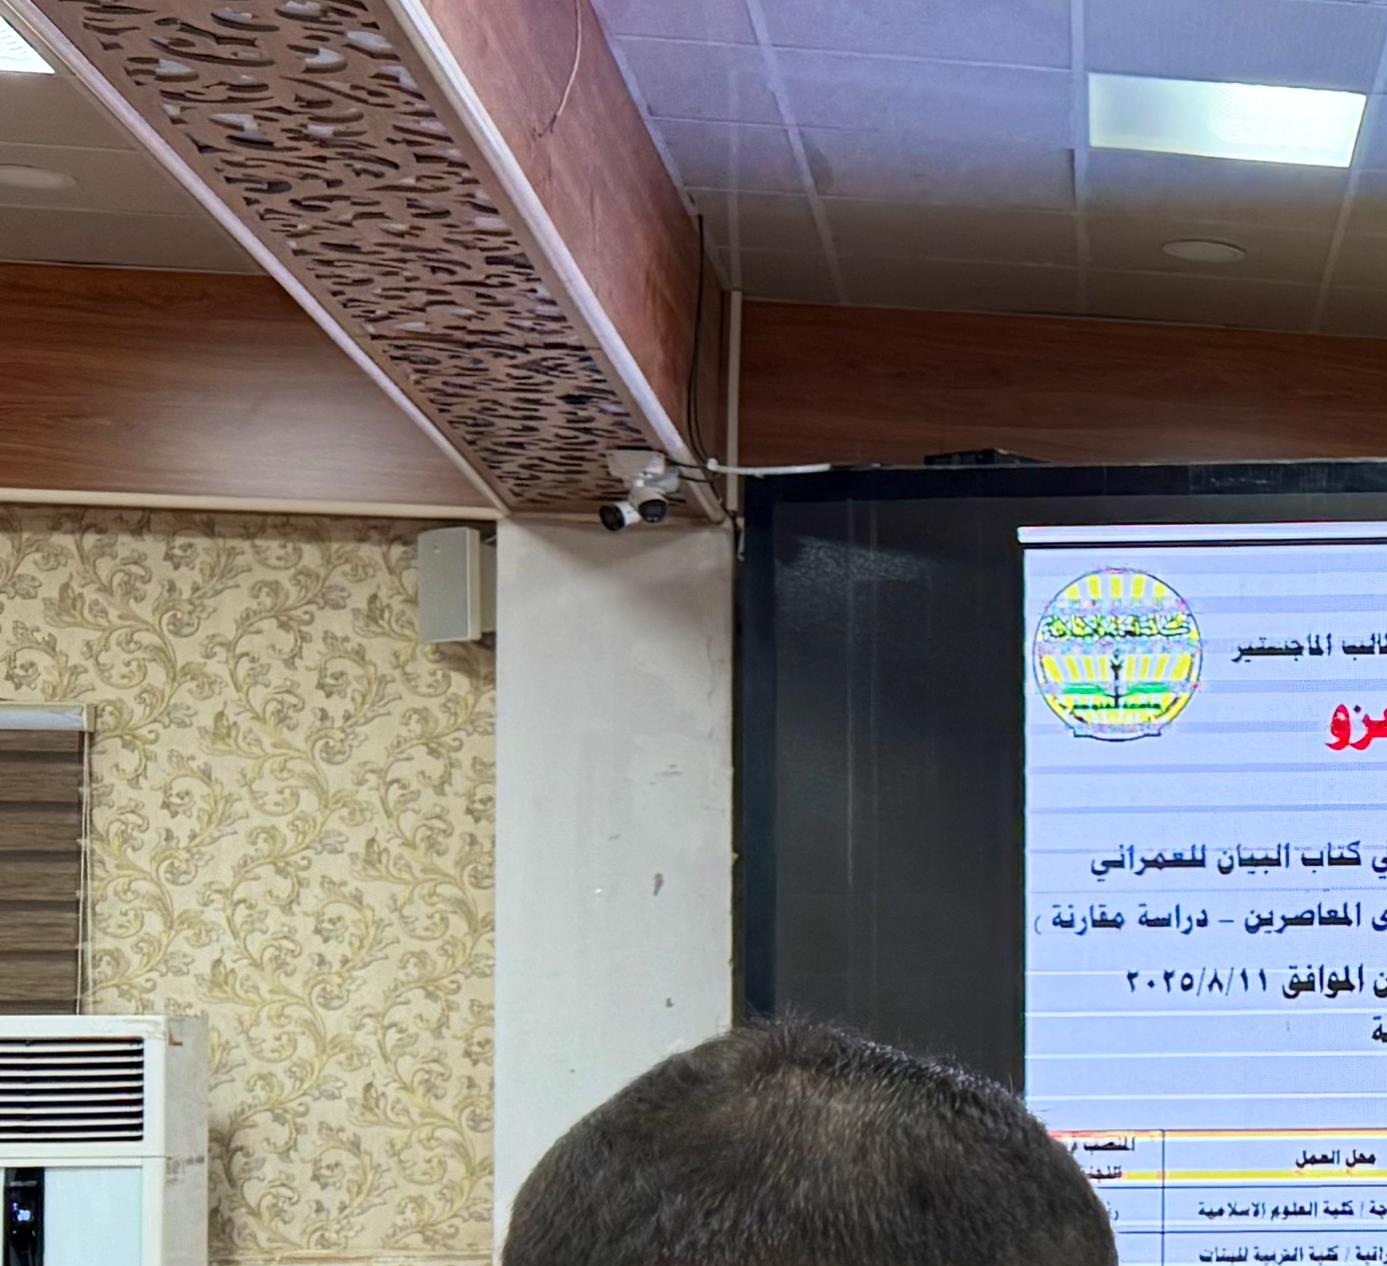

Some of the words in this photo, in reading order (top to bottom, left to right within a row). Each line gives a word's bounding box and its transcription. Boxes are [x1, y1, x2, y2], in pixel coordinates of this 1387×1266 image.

[1231, 633, 1332, 663] الماجستير
[1091, 844, 1206, 882] للعمراني
[1217, 842, 1290, 875] البيان
[1300, 840, 1362, 874] كتاب
[1138, 903, 1209, 935] دراسة
[1244, 901, 1361, 935] المعاصرين
[1282, 963, 1365, 1000] الموافق
[1296, 1150, 1340, 1169] العمل
[1346, 1149, 1376, 1168] محل
